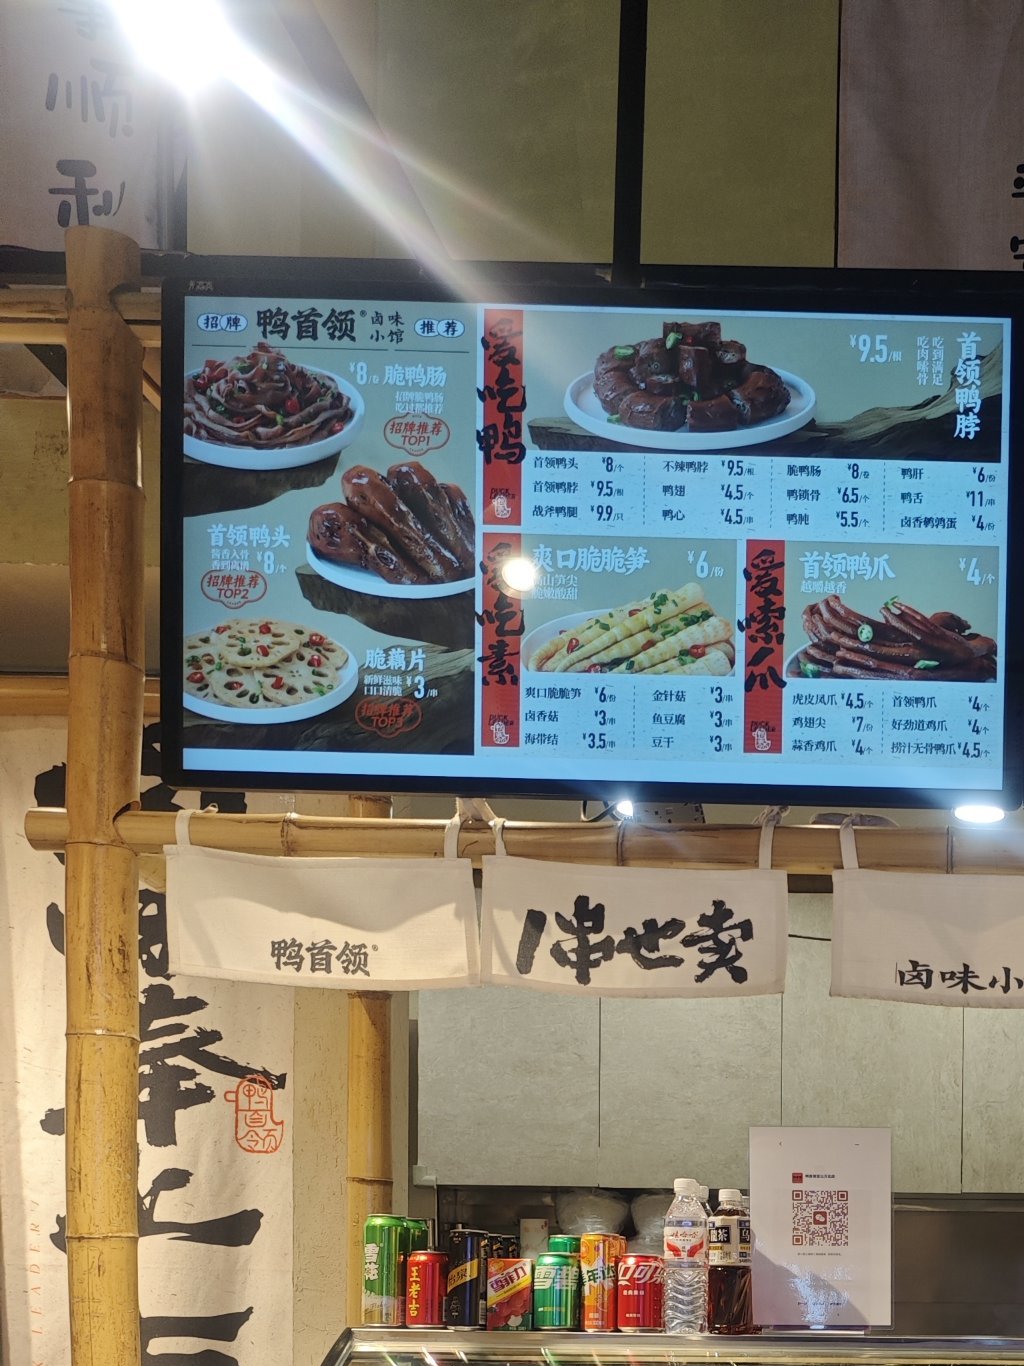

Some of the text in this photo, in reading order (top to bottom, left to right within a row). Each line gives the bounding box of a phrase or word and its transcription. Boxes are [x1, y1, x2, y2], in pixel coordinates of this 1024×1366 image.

[202, 316, 242, 329] 招牌
[256, 306, 357, 342] 鸭首领
[420, 320, 458, 334] 推荐
[383, 364, 447, 387] 脆鸭肠
[953, 332, 981, 440] 首领鸭脖
[390, 421, 442, 436] 招牌推荐
[402, 436, 431, 447] TOP1
[533, 456, 578, 469] 首领鸭头
[663, 460, 708, 473] 不辣鸭脖
[787, 465, 821, 478] 脆鸭肠
[901, 467, 924, 479] 鸭肝
[532, 480, 578, 494] 首领鸭脖
[662, 485, 685, 497] 鸭翅
[787, 489, 820, 501] 鸭锁骨
[901, 492, 923, 504] 鸭舌
[532, 505, 578, 518] 战斧鸭腿
[662, 509, 685, 521] 鸭心
[207, 524, 290, 548] 首领鸭头
[800, 552, 895, 581] 首领鸭爪
[206, 573, 260, 588] 招牌推荐
[217, 588, 249, 600] TOP2
[364, 648, 426, 672] 脆藕片
[652, 689, 686, 702] 金针菇
[793, 694, 837, 706] 虎皮凤爪
[892, 695, 937, 708] 首领鸭爪
[525, 710, 558, 723] 卤香菇
[652, 713, 685, 725] 鱼豆腐
[792, 717, 826, 729] 鸡翅尖
[892, 719, 947, 732] 好劲道鸡爪
[525, 733, 558, 745] 海带结
[652, 737, 674, 748] 豆干
[792, 740, 837, 752] 蒜香鸡爪
[270, 938, 372, 977] 鸭首领
[534, 1265, 579, 1290] 雪碧
[409, 1266, 421, 1317] 王老吉
